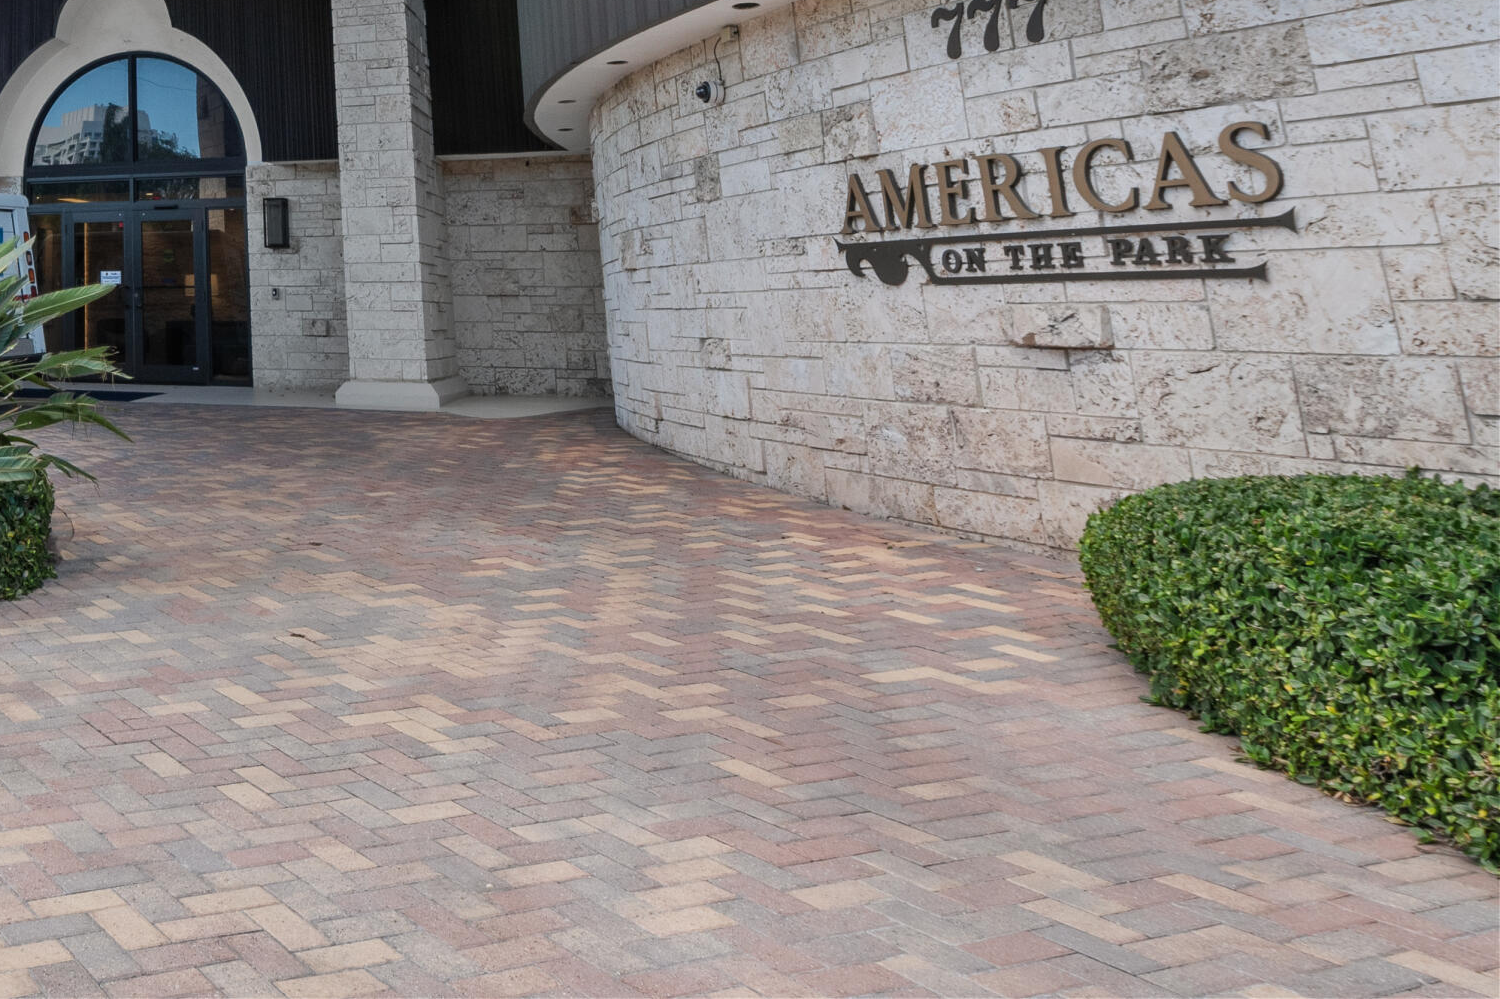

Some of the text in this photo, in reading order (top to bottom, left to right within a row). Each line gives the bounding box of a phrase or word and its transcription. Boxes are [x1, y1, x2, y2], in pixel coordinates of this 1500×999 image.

[840, 121, 1285, 235] AMERICAS
[941, 234, 1236, 274] ON THE PARK
